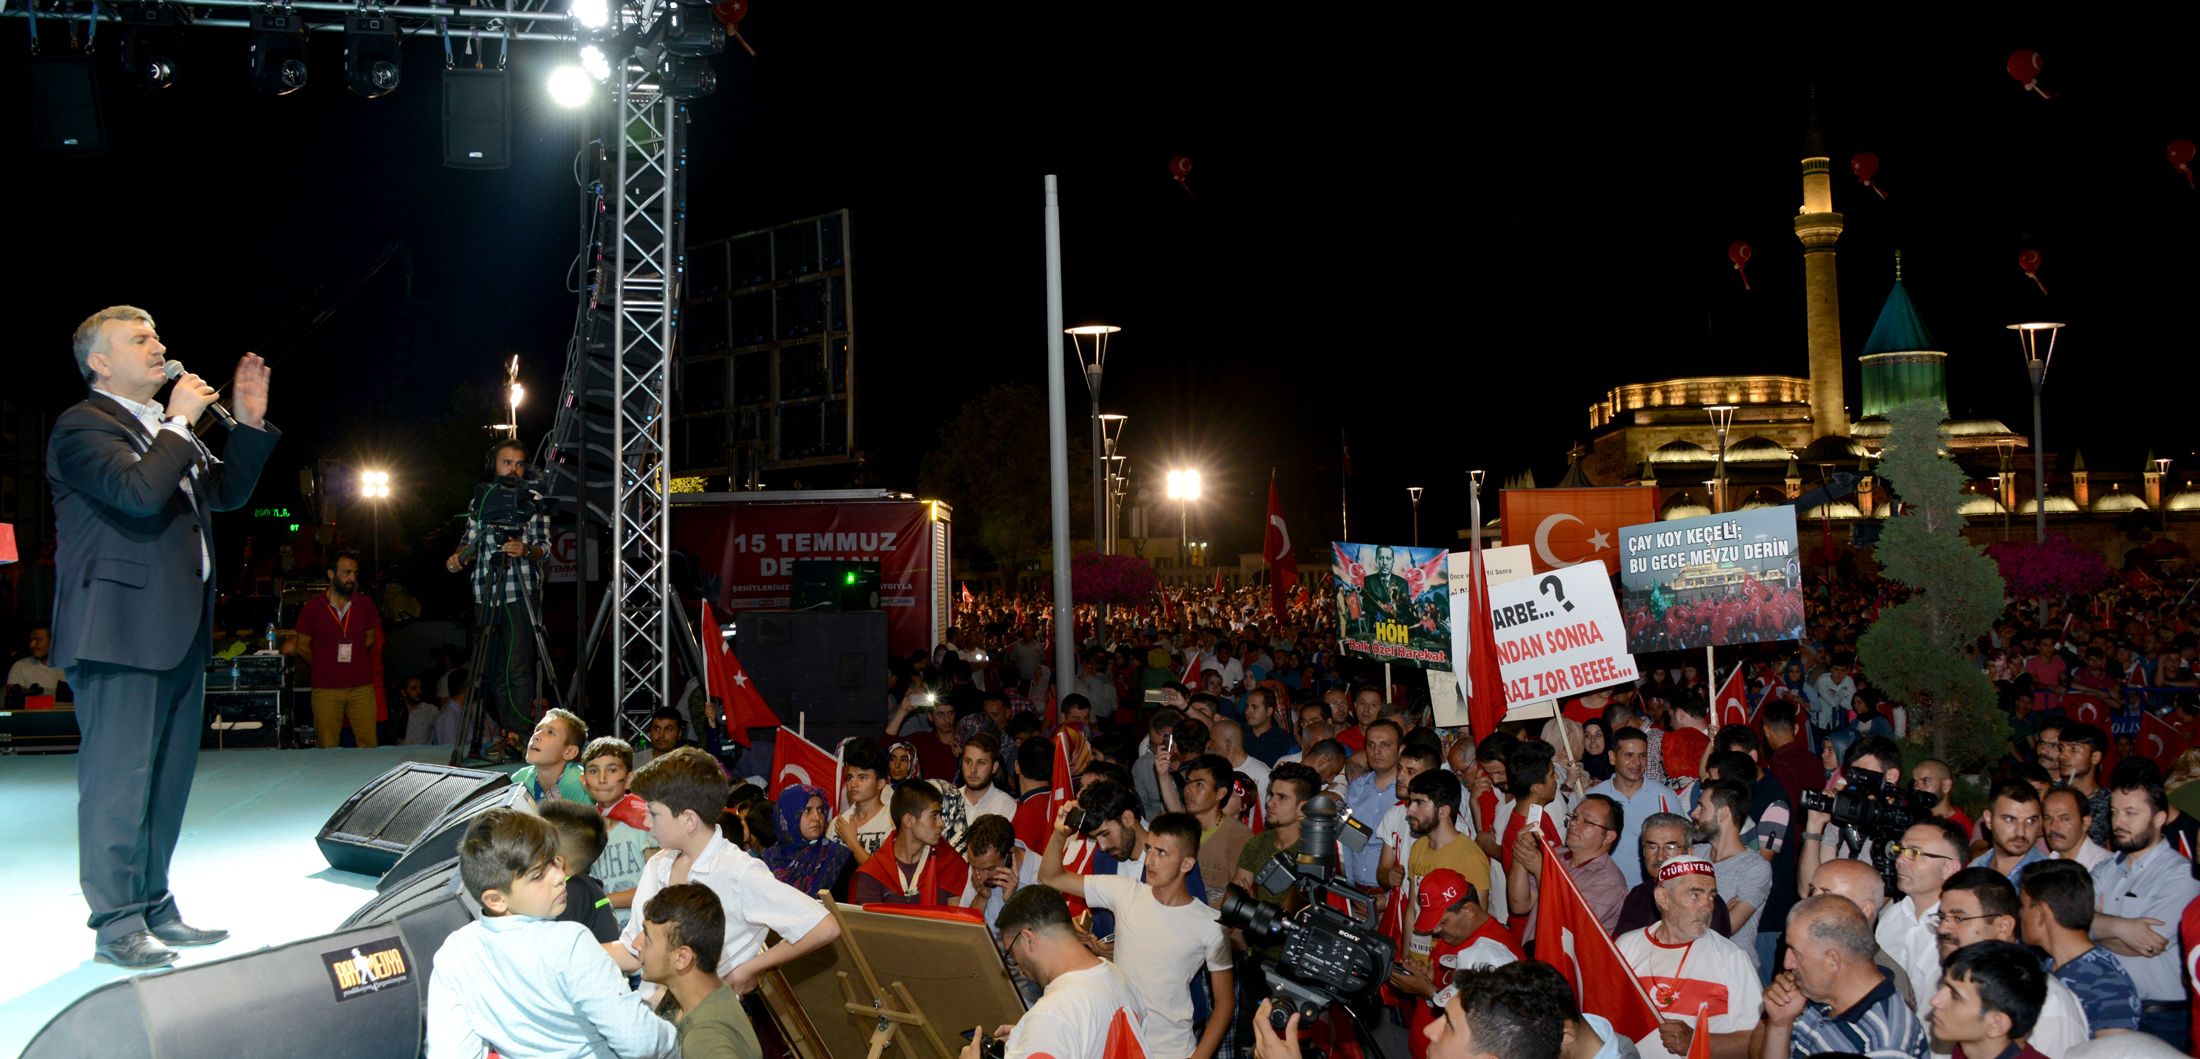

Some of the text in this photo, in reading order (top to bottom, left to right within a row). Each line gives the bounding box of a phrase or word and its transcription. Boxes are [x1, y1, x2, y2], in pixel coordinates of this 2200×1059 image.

[735, 532, 897, 553] 15 TEMMUZ
[1628, 534, 1652, 556] ÇAY
[1657, 530, 1682, 548] KOY
[1629, 537, 1789, 574] BU GECE MEVZU DERİN
[1376, 618, 1409, 644] HÖH
[1546, 620, 1604, 654] SONRA
[1349, 638, 1446, 662] Halk Özel Harekat
[1533, 668, 1571, 697] ZOR
[1569, 656, 1632, 689] BEEEE...
[1338, 929, 1360, 942] SONY
